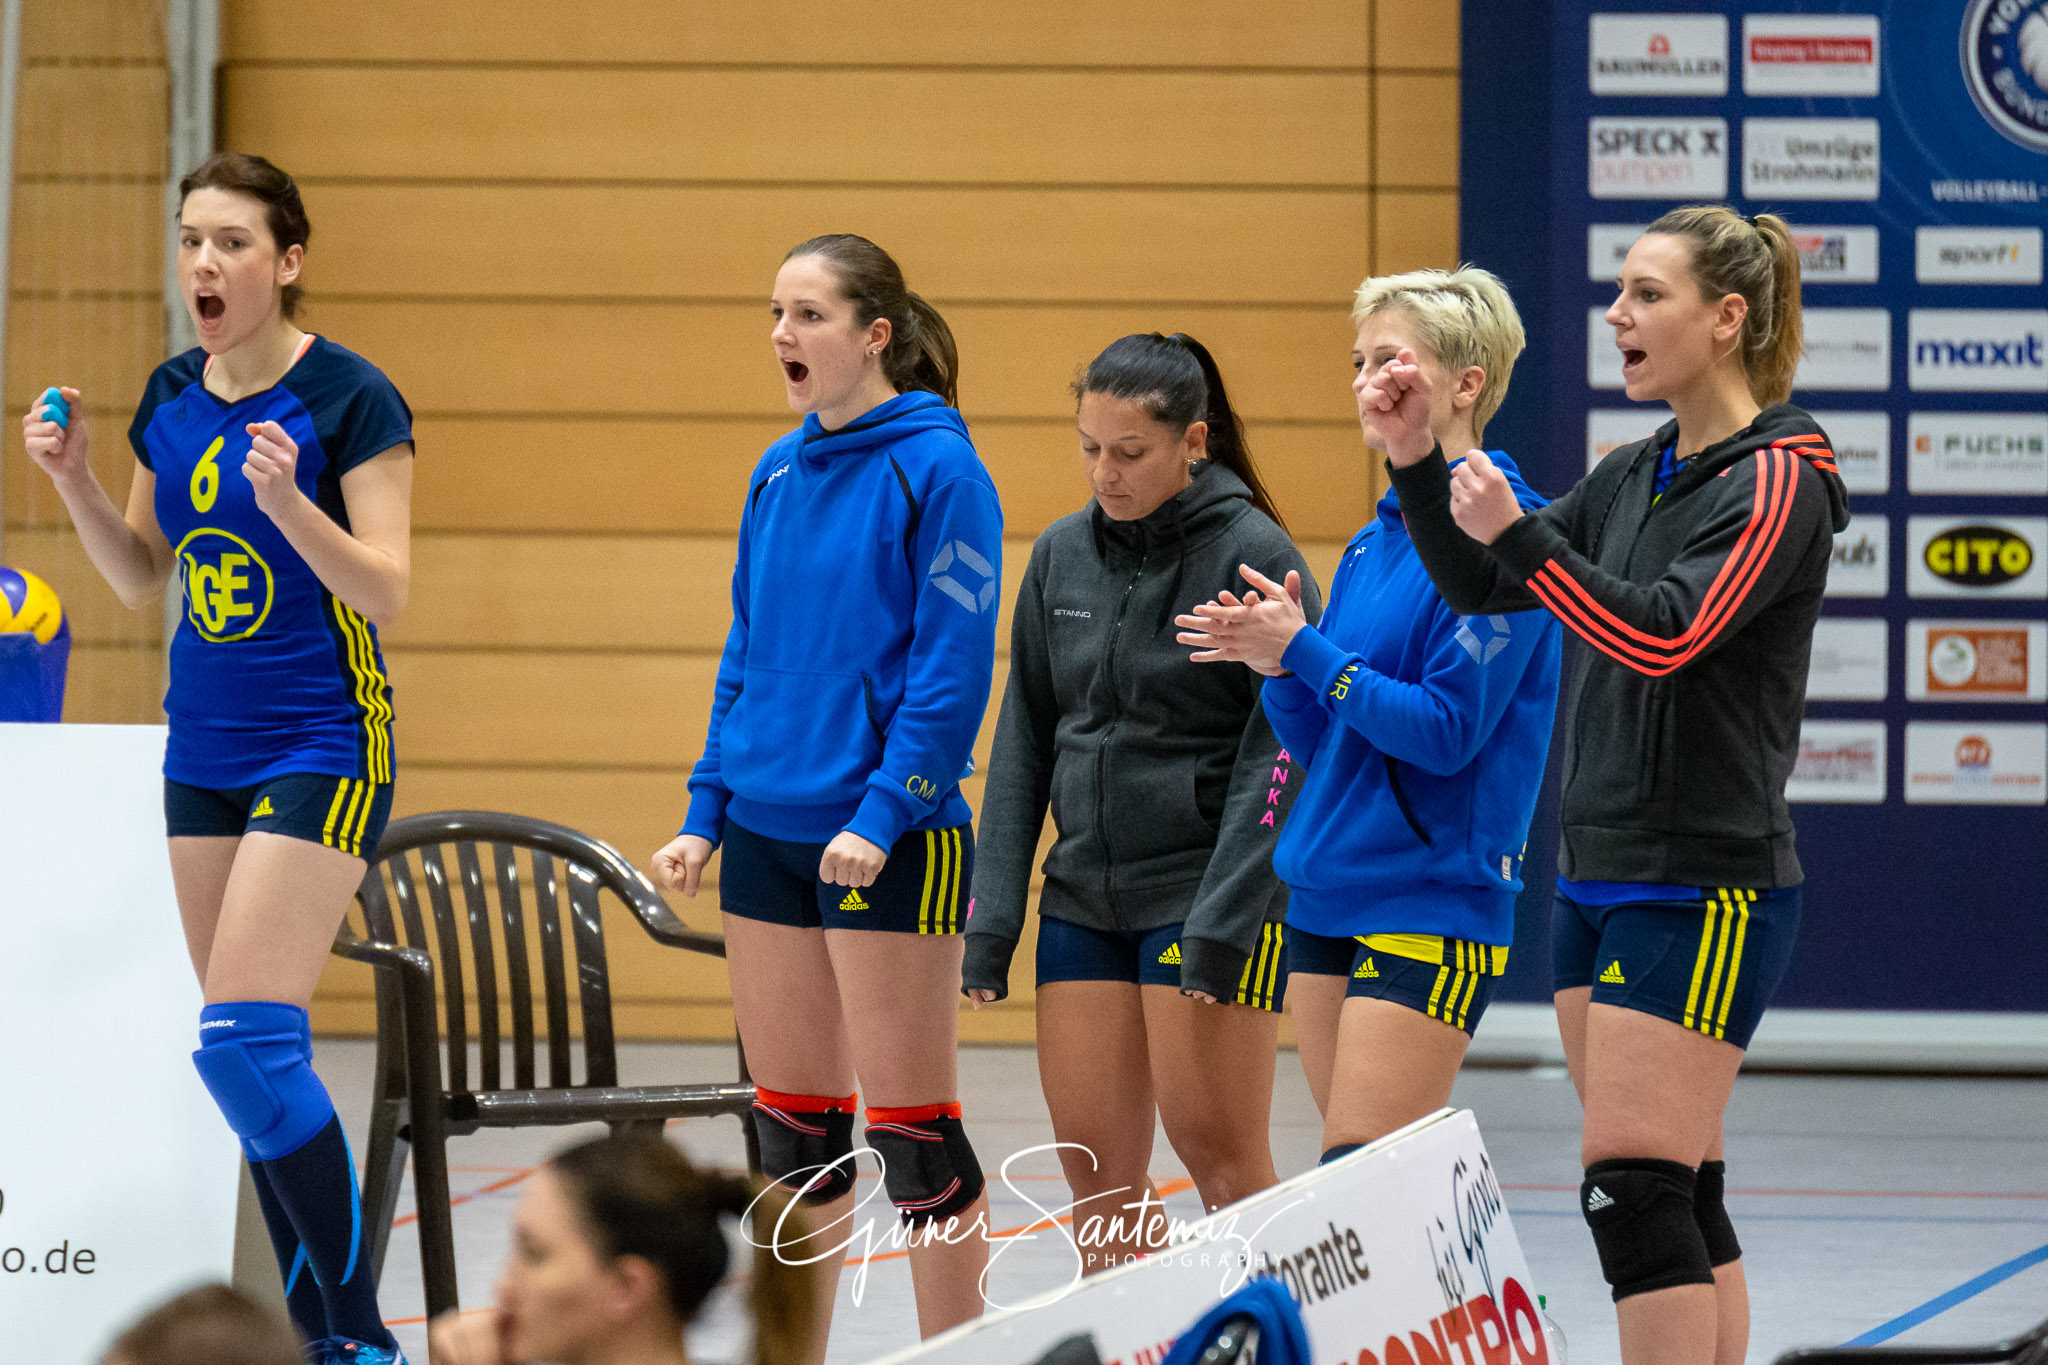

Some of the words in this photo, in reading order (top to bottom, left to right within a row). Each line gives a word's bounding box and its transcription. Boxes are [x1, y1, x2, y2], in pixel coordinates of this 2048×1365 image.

[1596, 127, 1689, 155] SPECK
[1786, 134, 1874, 161] Umzüge
[1594, 157, 1694, 184] pumpen
[1752, 161, 1875, 184] Strohmann
[1916, 332, 2043, 367] maxit
[1944, 434, 2043, 456] FUCHS
[190, 436, 224, 513] 6
[1925, 538, 2031, 576] CITO
[1054, 609, 1091, 617] STANNO
[906, 775, 936, 800] CM
[1260, 748, 1291, 828] ANKA
[839, 902, 870, 911] adidas
[1353, 969, 1380, 979] adidas
[2, 1239, 96, 1275] o.de
